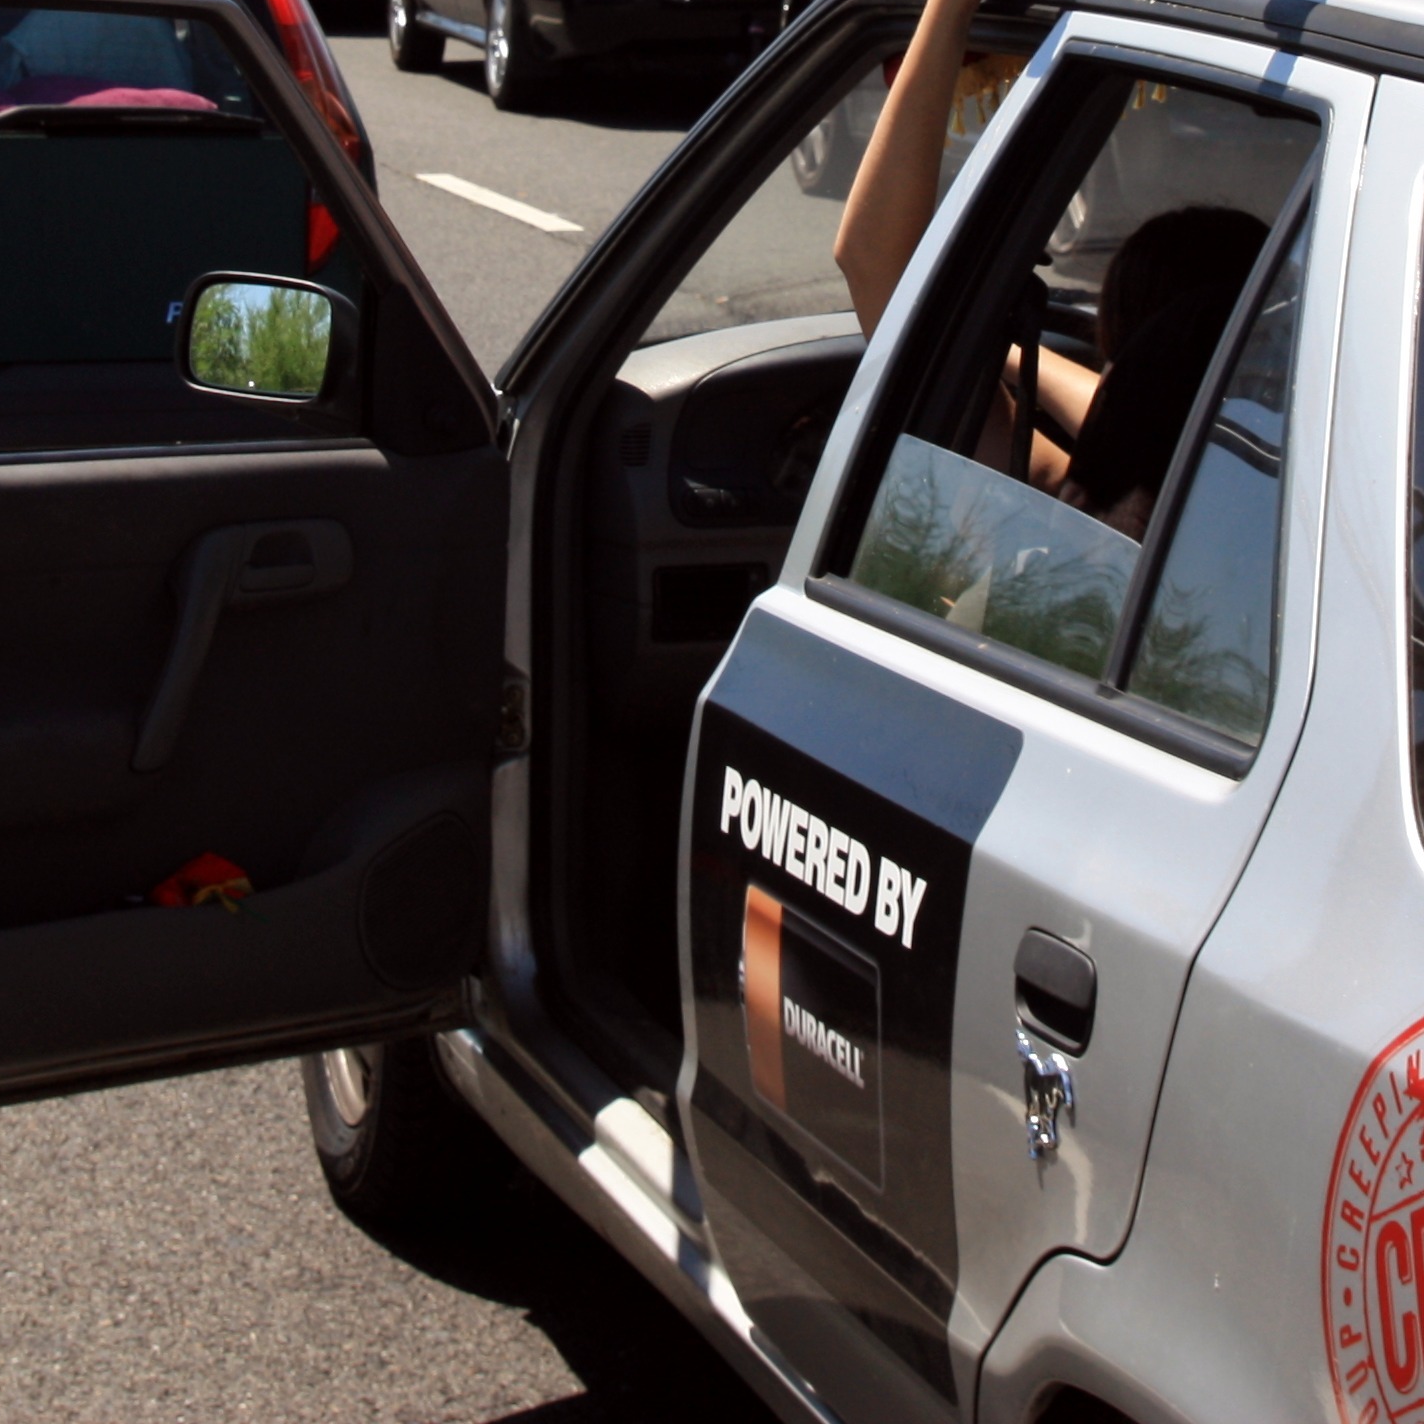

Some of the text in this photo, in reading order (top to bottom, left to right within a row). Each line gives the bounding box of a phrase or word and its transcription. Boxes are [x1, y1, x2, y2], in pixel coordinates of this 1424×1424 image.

[720, 765, 927, 950] POWERED BY
[783, 995, 866, 1090] DURACELL
